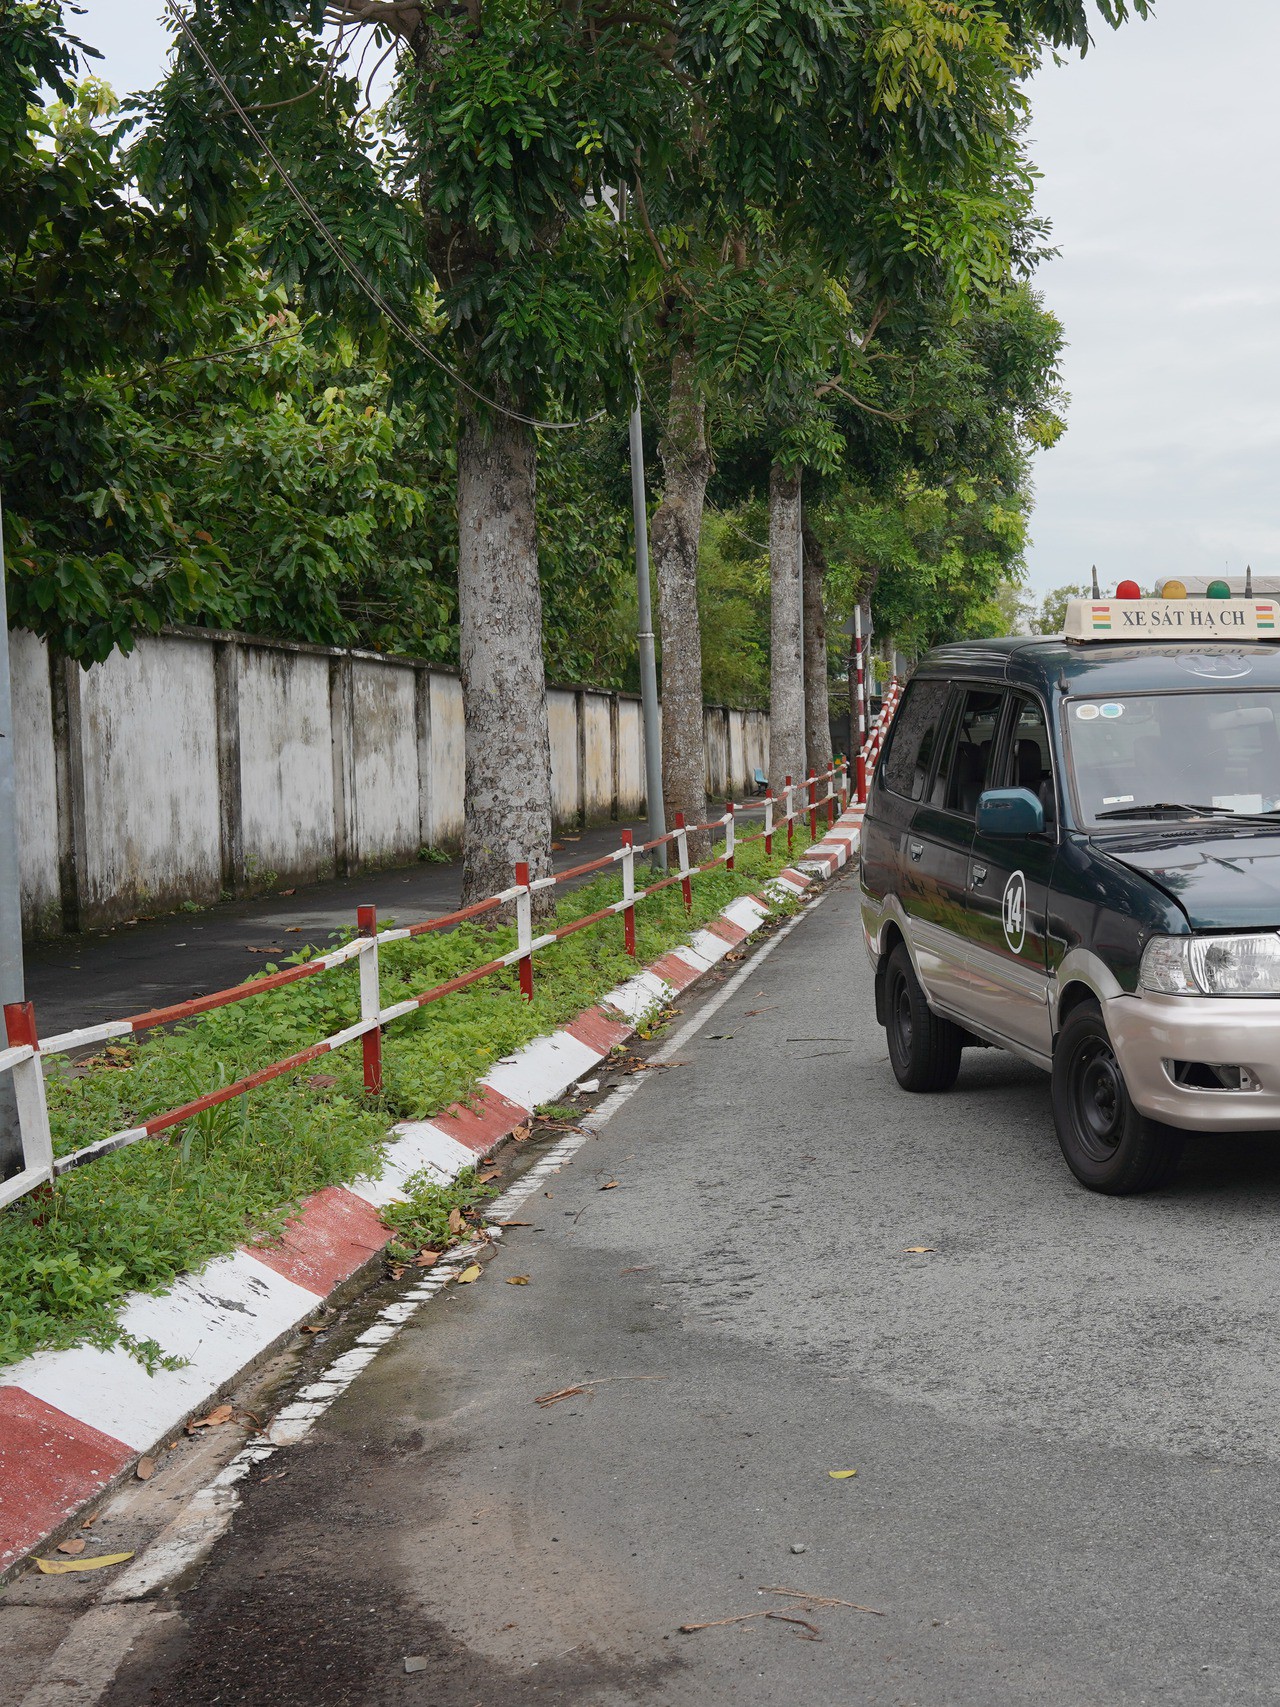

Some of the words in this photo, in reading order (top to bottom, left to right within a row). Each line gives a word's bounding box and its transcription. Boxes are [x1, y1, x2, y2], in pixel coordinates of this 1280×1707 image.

[1122, 611, 1147, 626] XE
[1151, 605, 1185, 626] SÁT
[1007, 887, 1022, 933] 14
